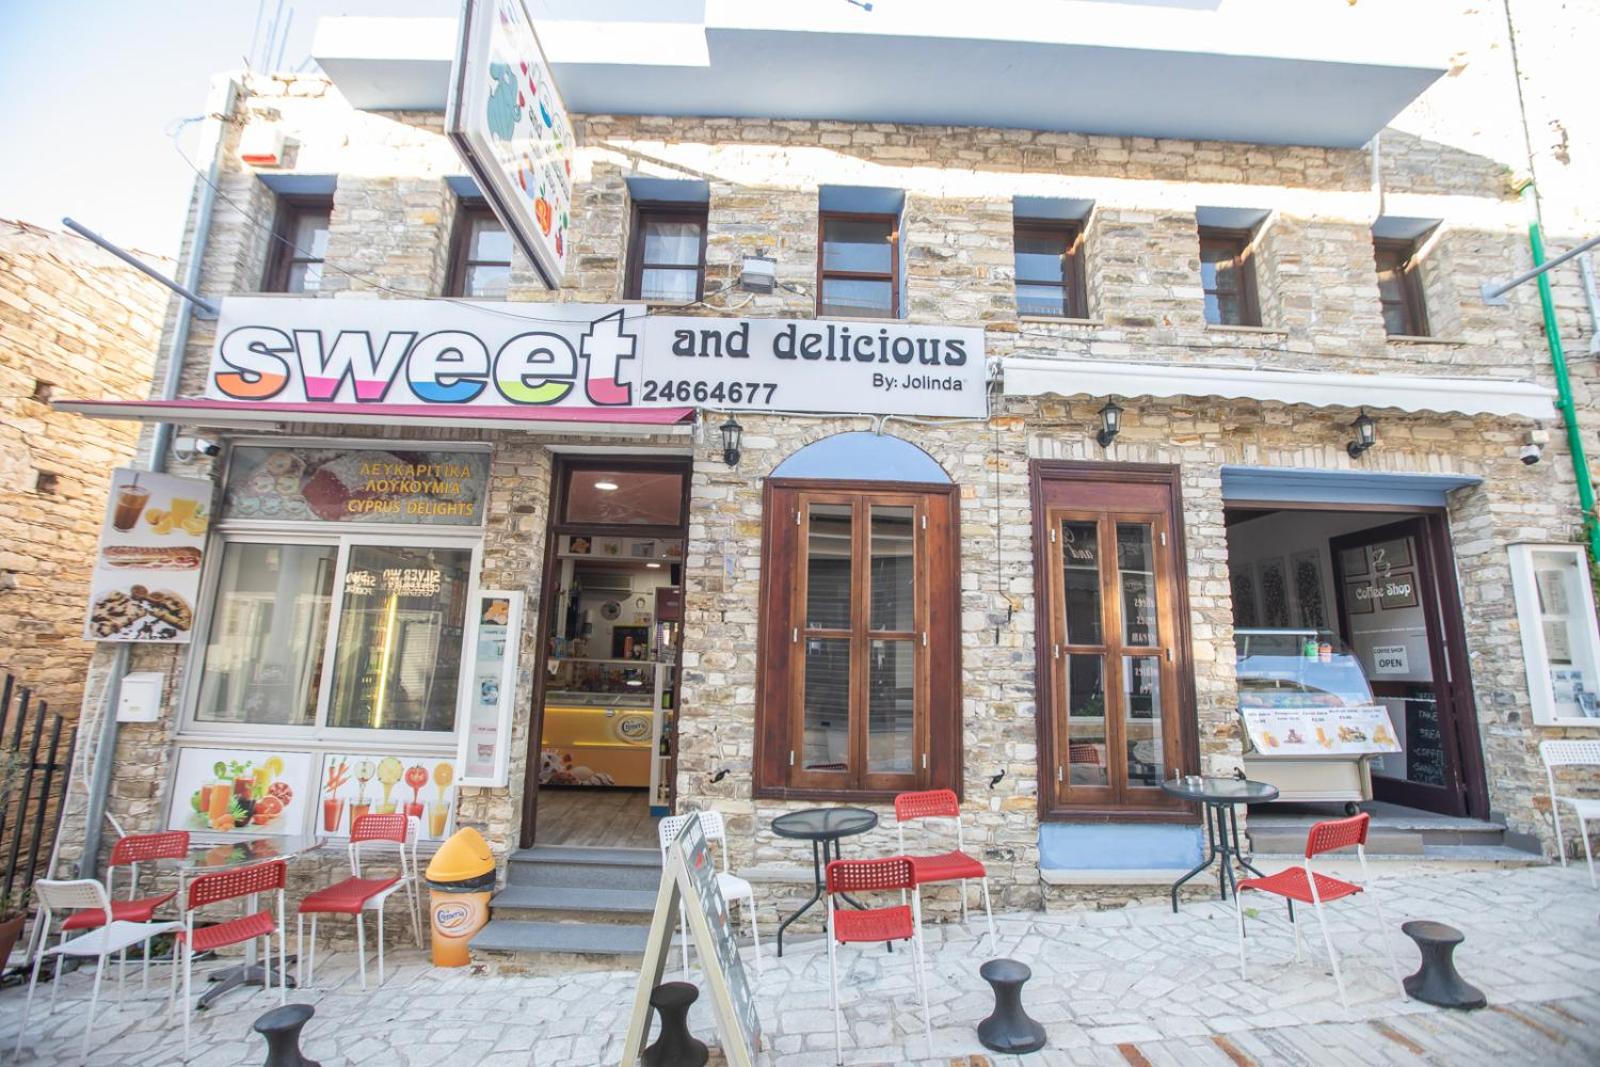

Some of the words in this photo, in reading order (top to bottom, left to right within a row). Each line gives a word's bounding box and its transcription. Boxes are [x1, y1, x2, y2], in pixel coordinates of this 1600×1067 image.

[672, 322, 750, 358] and
[773, 324, 968, 367] delicious
[214, 308, 637, 406] sweet
[872, 373, 898, 389] By:
[902, 374, 963, 391] Jolinda
[642, 380, 778, 405] 24664677
[360, 463, 471, 478] ΛΕΥΚΑΡΙΤΙΚΑ
[365, 479, 460, 494] ΛΟΥΚΟΥΜΙΑ
[347, 499, 401, 513] CYPRUS
[407, 501, 474, 516] DELIGHTS
[1355, 586, 1384, 600] Coffee
[1386, 583, 1411, 597] Shop
[1379, 659, 1403, 668] OPEN
